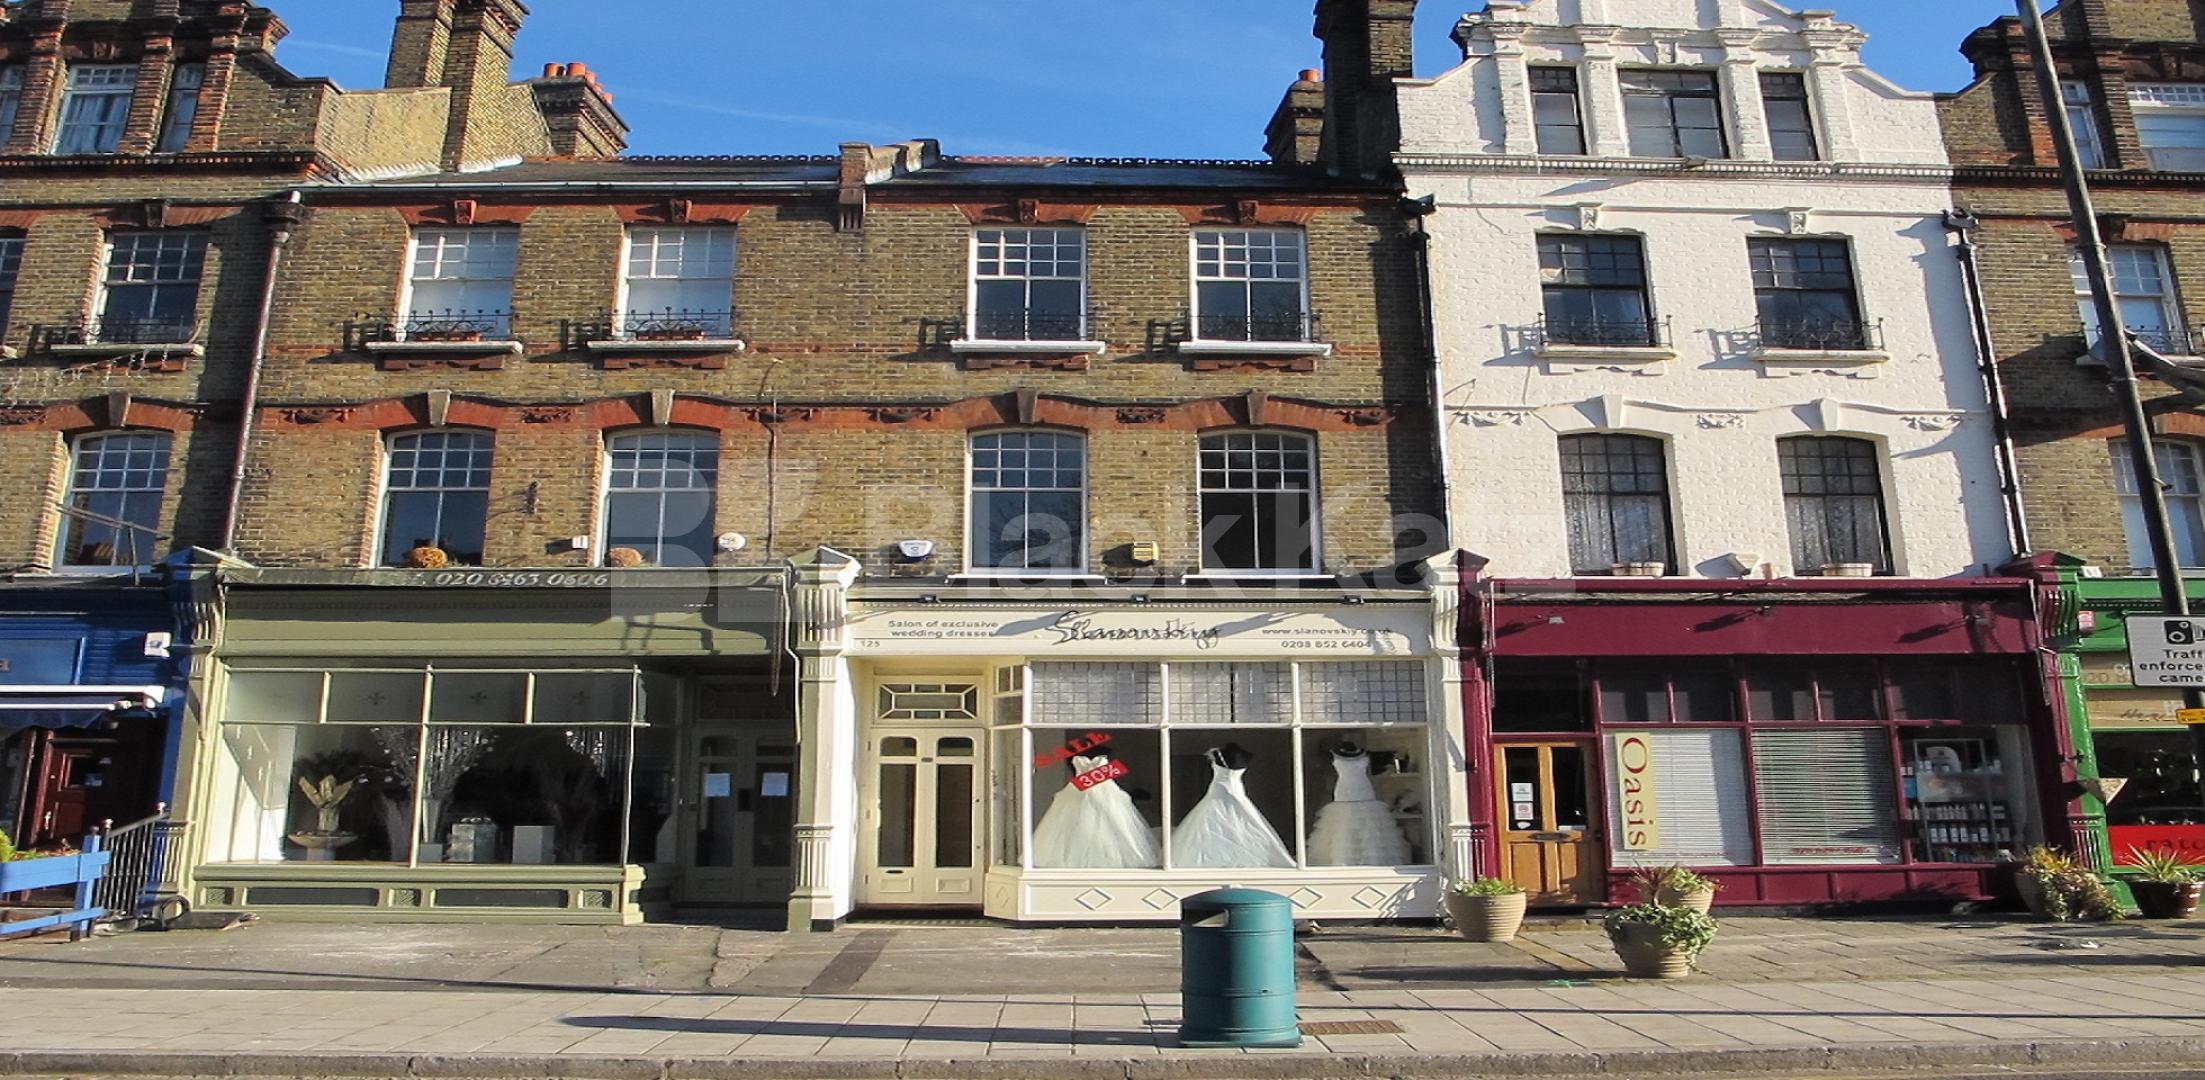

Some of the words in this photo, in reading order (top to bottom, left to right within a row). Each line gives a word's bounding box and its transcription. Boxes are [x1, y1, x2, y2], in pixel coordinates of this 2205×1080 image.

[434, 573, 483, 586] 020
[888, 620, 922, 628] Salon
[926, 620, 938, 628] of
[941, 620, 998, 628] exclusive
[891, 630, 942, 639] wedding
[861, 640, 880, 648] 125
[1281, 640, 1311, 648] 0208
[1315, 640, 1337, 648] 852
[1342, 640, 1372, 648] 6404
[1034, 731, 1113, 769] SALE
[1079, 764, 1121, 787] 30%
[1621, 737, 1655, 846] Oasis
